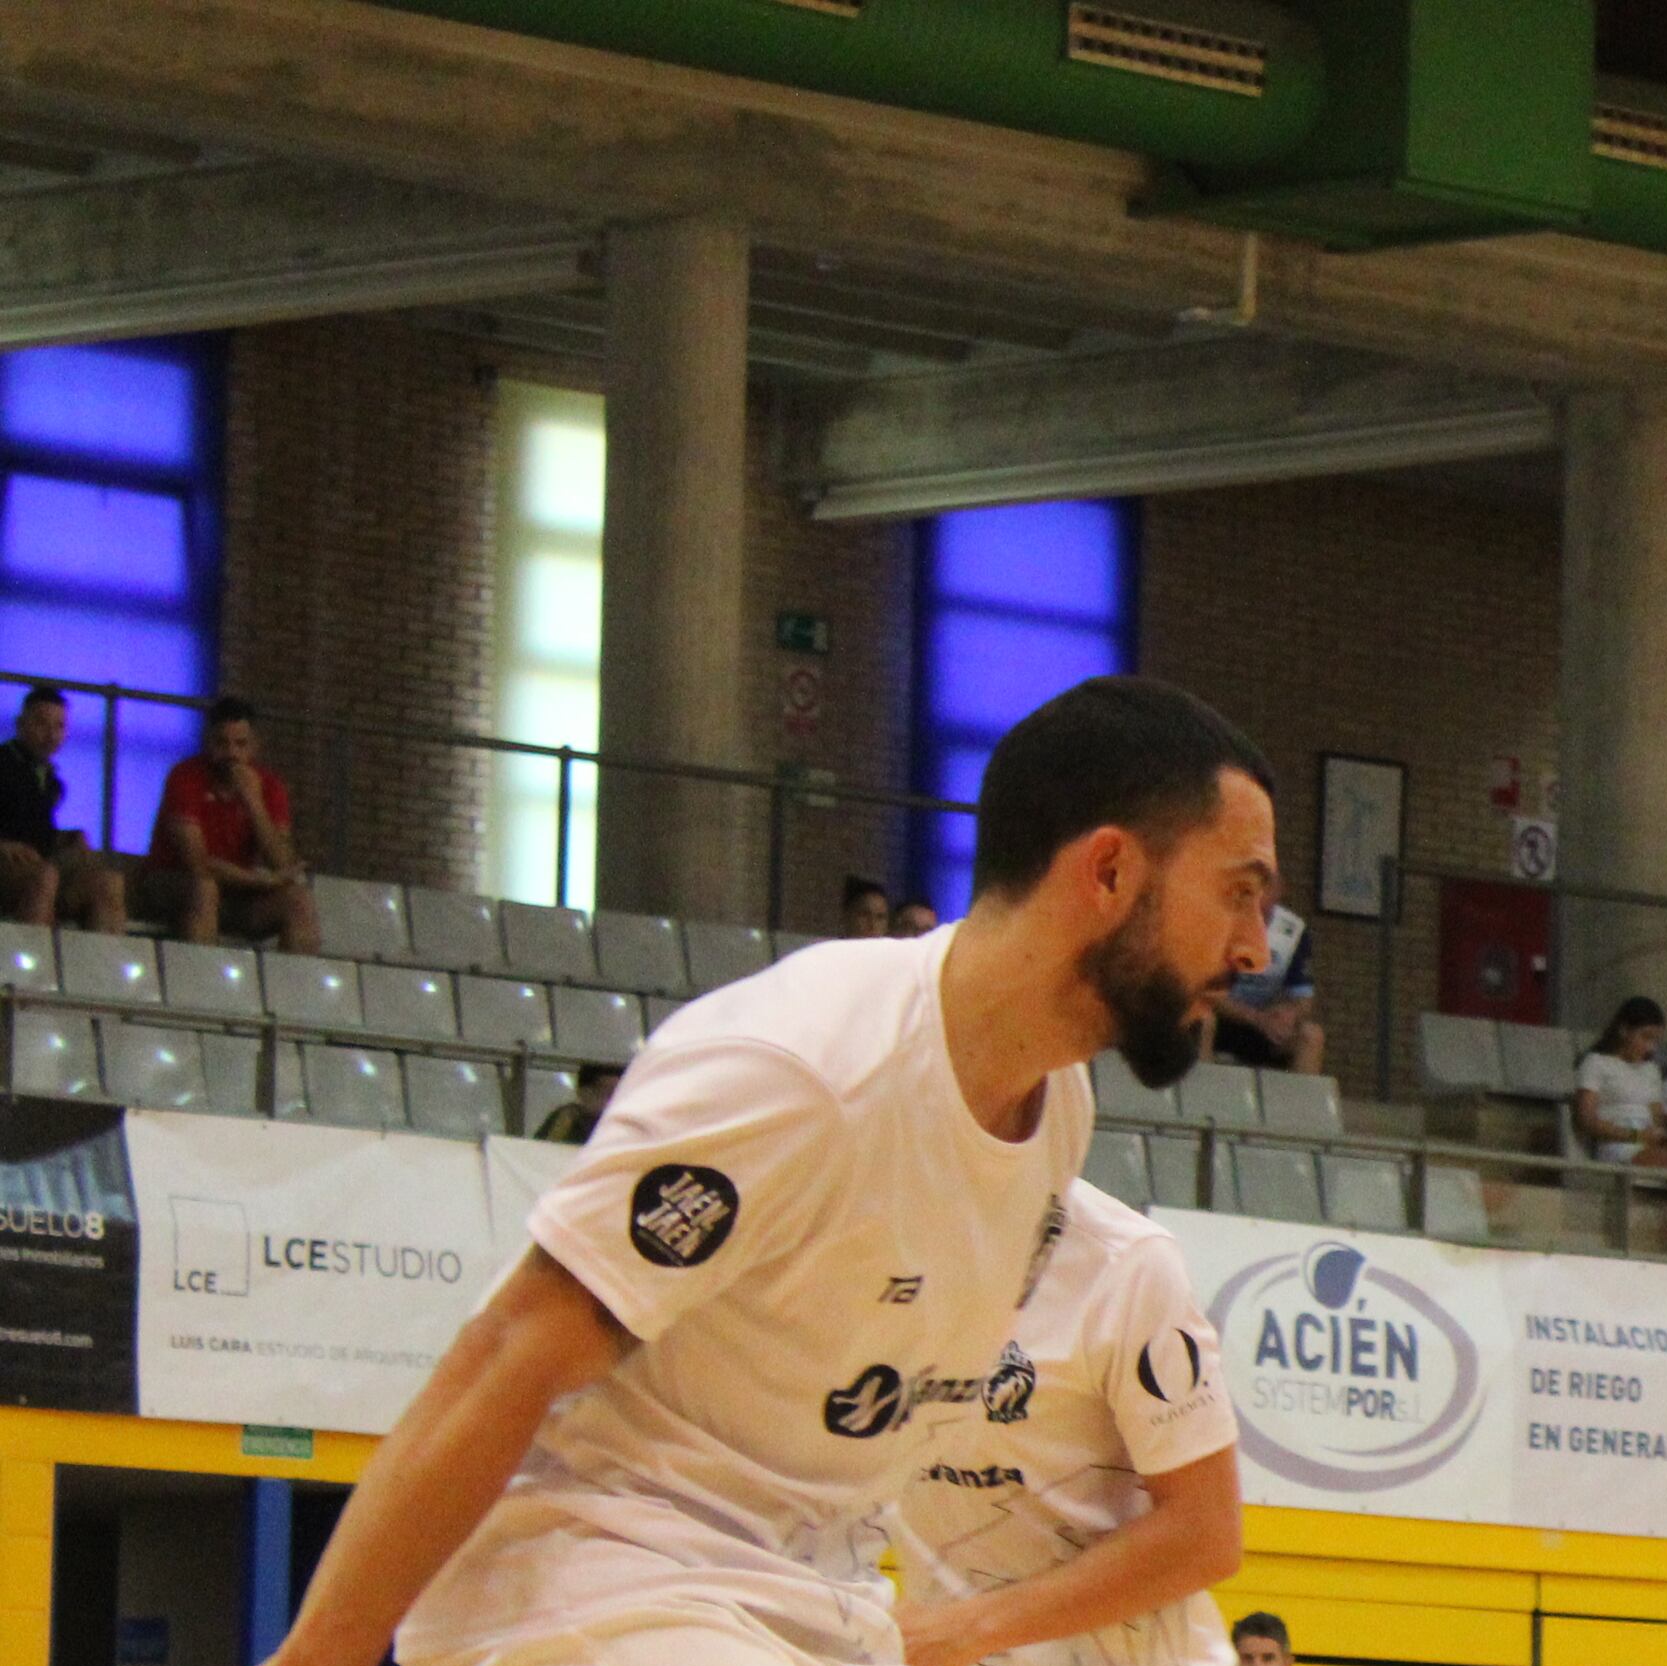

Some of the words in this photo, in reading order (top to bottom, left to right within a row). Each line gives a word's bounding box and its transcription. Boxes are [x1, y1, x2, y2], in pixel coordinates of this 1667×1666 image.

[263, 1235, 463, 1285] LCESTUDIO
[173, 1269, 218, 1294] LCE
[1254, 1298, 1419, 1383] ACIÉN
[1531, 1368, 1560, 1397] DE
[1569, 1371, 1643, 1403] RIEGO
[1529, 1423, 1562, 1452] EN
